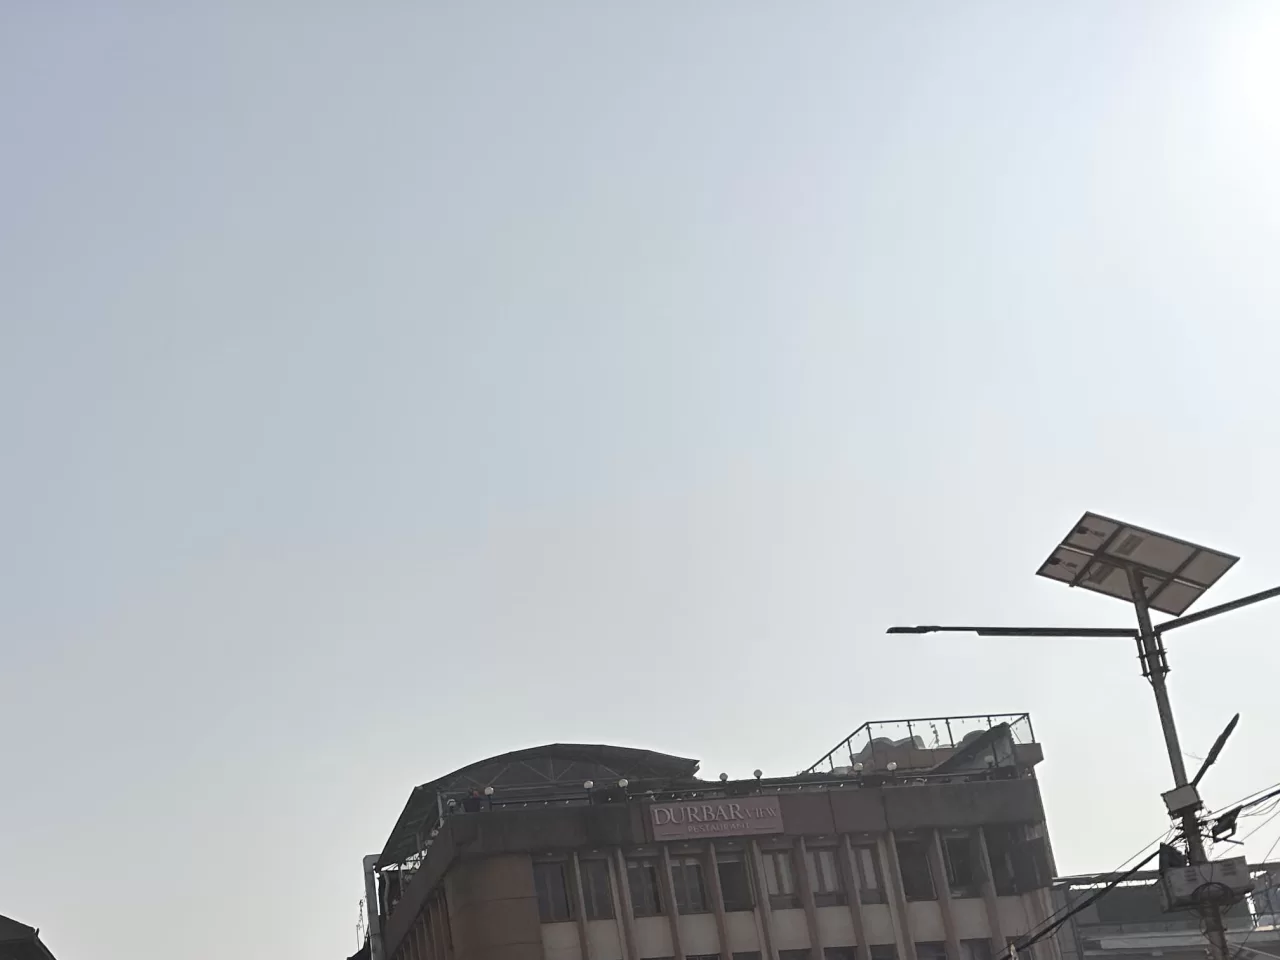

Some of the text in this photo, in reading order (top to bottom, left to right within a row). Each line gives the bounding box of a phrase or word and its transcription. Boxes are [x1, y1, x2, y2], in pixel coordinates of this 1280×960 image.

[653, 803, 777, 825] DURBAR VIEW
[687, 822, 750, 833] RESTAURANT
